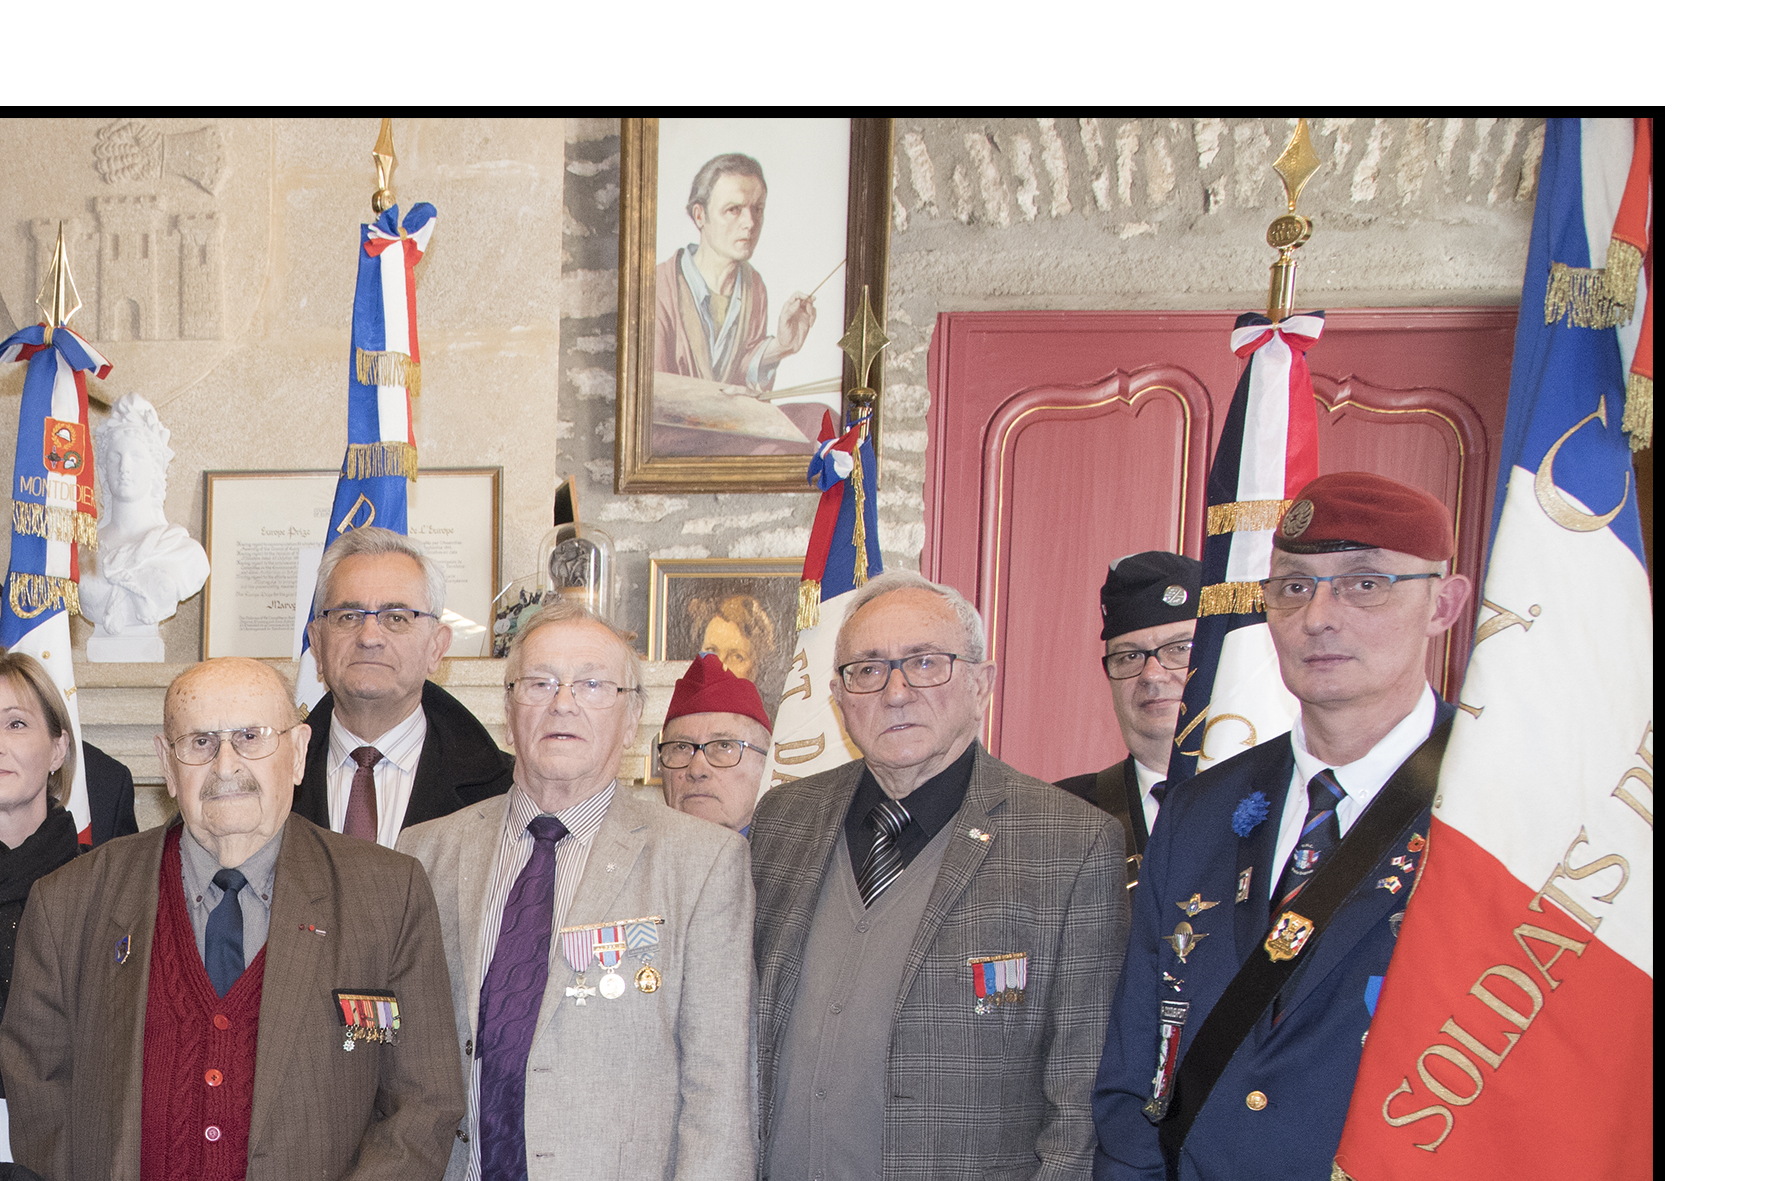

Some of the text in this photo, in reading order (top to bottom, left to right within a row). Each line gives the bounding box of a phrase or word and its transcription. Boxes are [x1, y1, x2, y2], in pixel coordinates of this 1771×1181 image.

[260, 526, 286, 538] Europe
[288, 525, 311, 539] Prize
[1382, 824, 1631, 1154] SOLDATS
